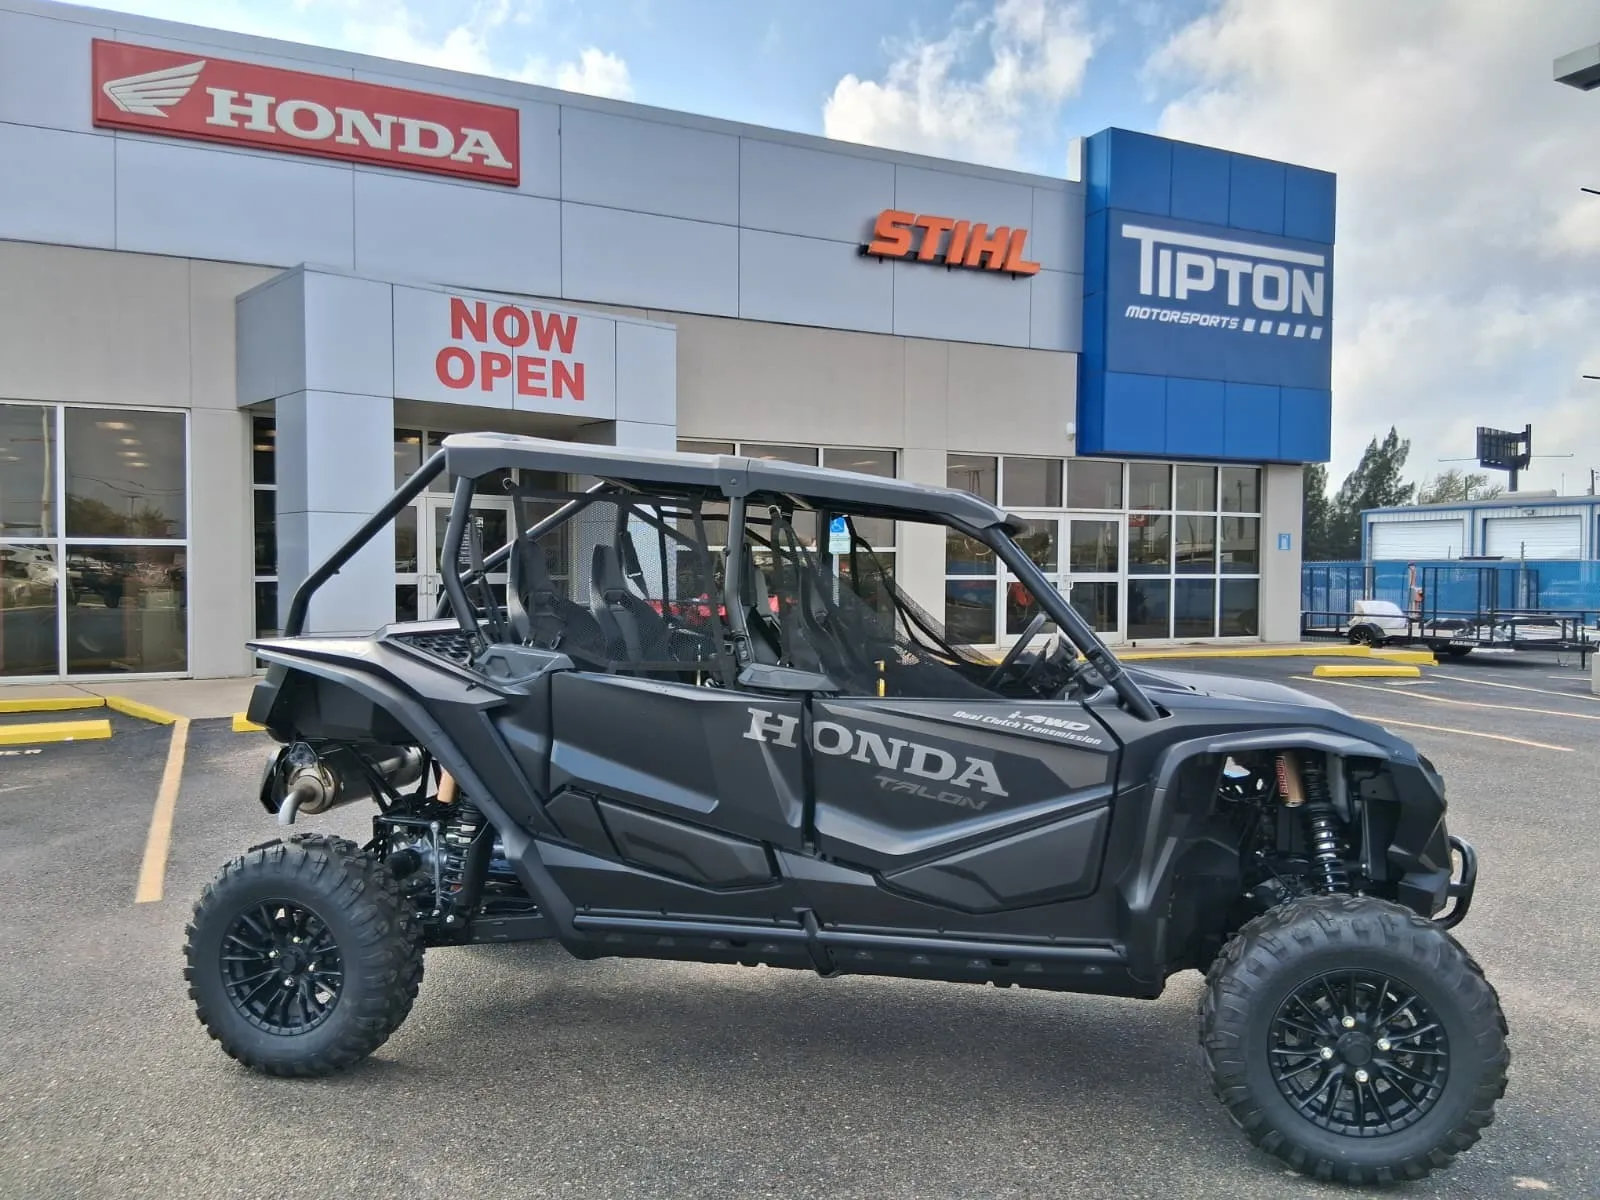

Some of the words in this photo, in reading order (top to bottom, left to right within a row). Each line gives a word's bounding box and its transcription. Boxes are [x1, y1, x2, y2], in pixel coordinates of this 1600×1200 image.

[206, 87, 512, 169] HONDA
[868, 208, 1041, 275] STIHL
[1122, 224, 1325, 317] TIPTON
[450, 297, 578, 354] NOW
[1125, 305, 1240, 330] MOTORSPORTS
[435, 346, 585, 401] OPEN
[952, 710, 983, 722] Dual
[982, 715, 1022, 729] Clutch
[1021, 722, 1103, 745] Transmission
[1008, 710, 1091, 732] i-4WD
[743, 707, 1009, 798] HONDA
[874, 775, 989, 811] TALON
